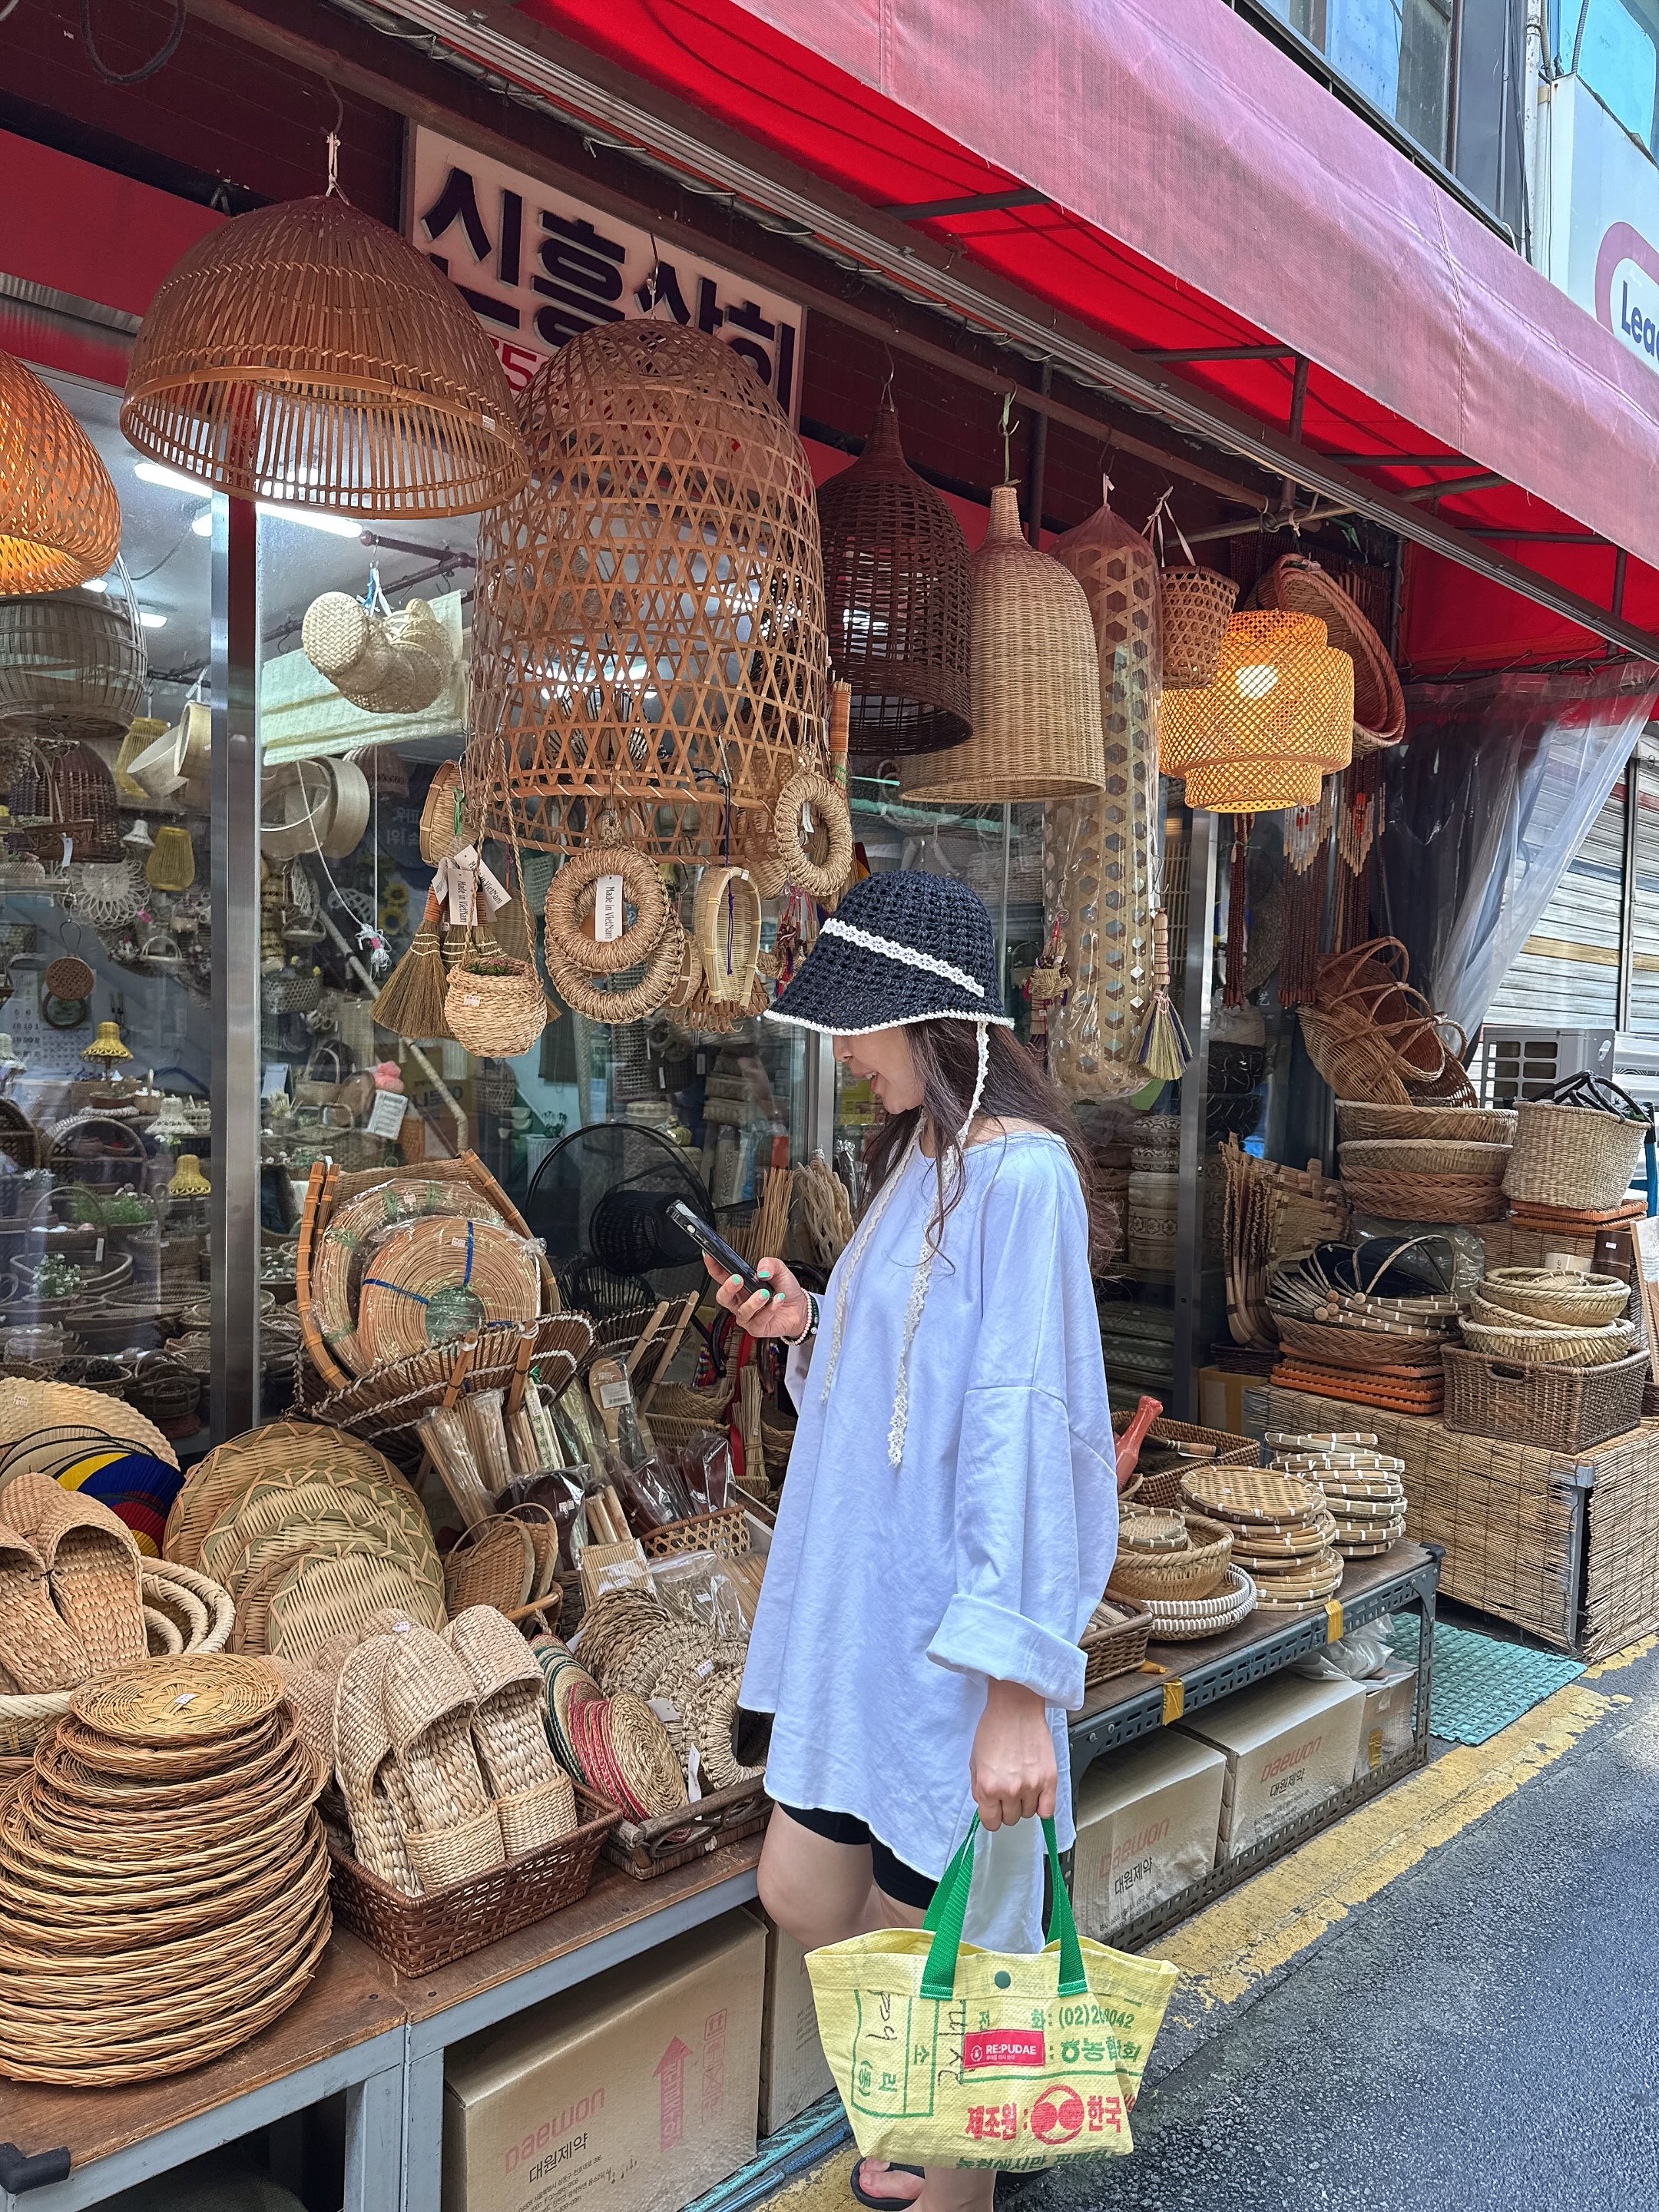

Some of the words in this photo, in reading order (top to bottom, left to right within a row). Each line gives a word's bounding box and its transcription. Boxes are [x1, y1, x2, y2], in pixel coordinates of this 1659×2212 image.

[1621, 280, 1659, 363] Lea
[468, 860, 482, 876] Mae
[605, 886, 615, 903] Made
[604, 912, 614, 939] VietNam
[1270, 1767, 1306, 1796] 대원제약
[1114, 1856, 1152, 1896] 대원제약
[985, 2044, 1037, 2055] RE:PUDAE
[529, 2131, 588, 2184] 대원제약
